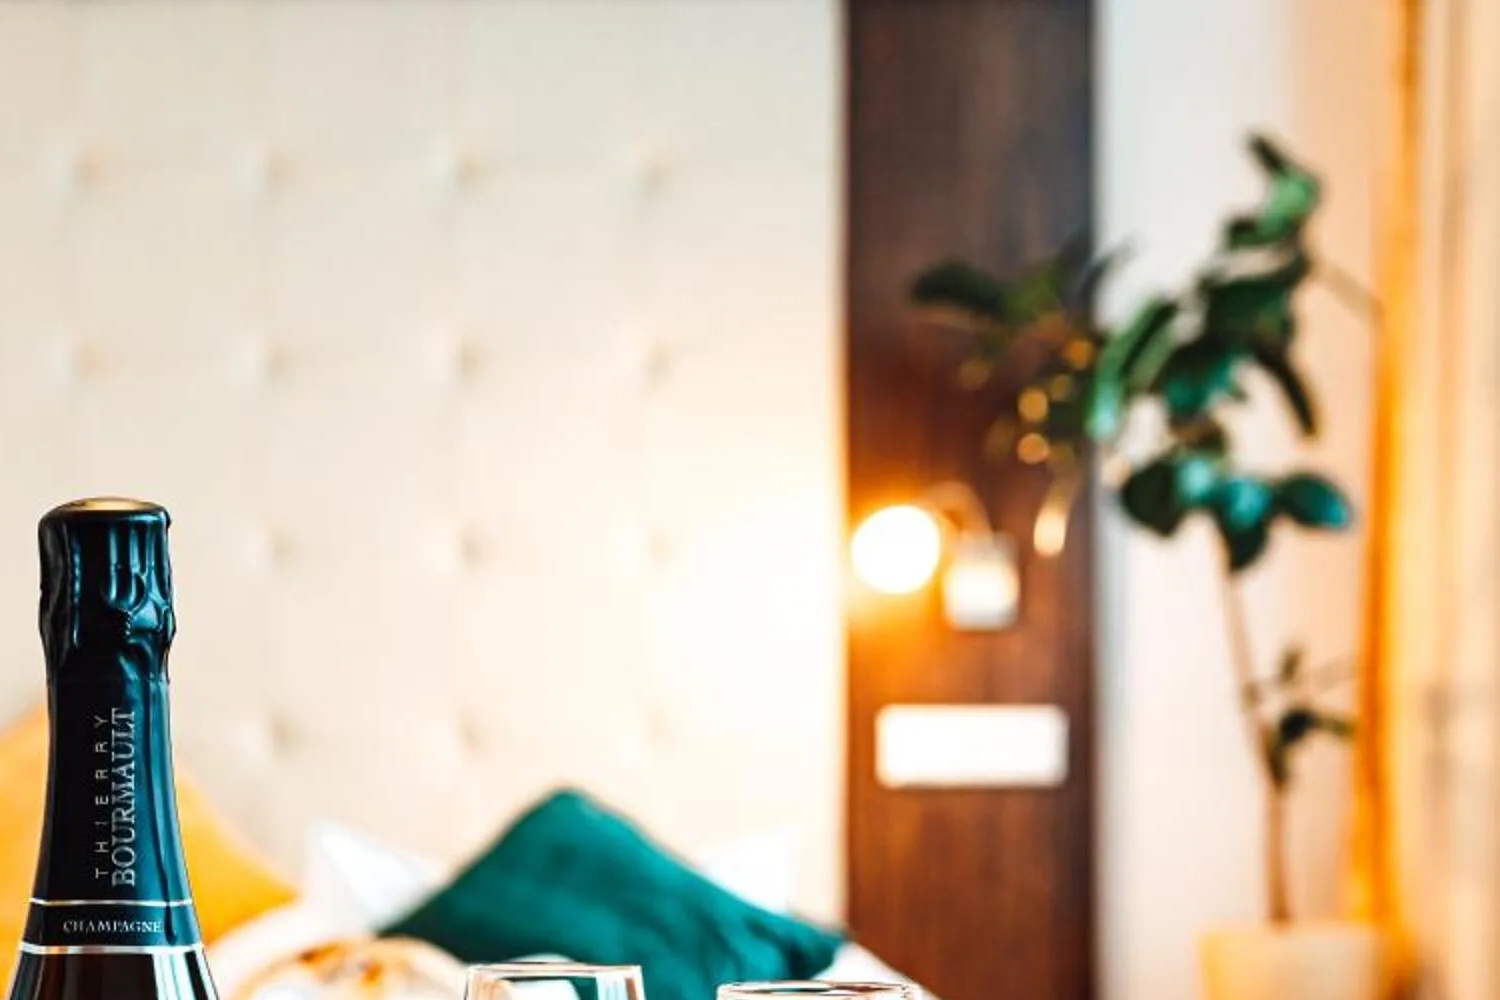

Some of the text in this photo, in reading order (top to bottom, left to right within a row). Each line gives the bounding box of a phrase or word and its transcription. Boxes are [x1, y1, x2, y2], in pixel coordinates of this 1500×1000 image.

[95, 714, 109, 878] THIERRY
[111, 707, 135, 887] BOURMAULT
[62, 919, 162, 934] CHAMPAGNE
